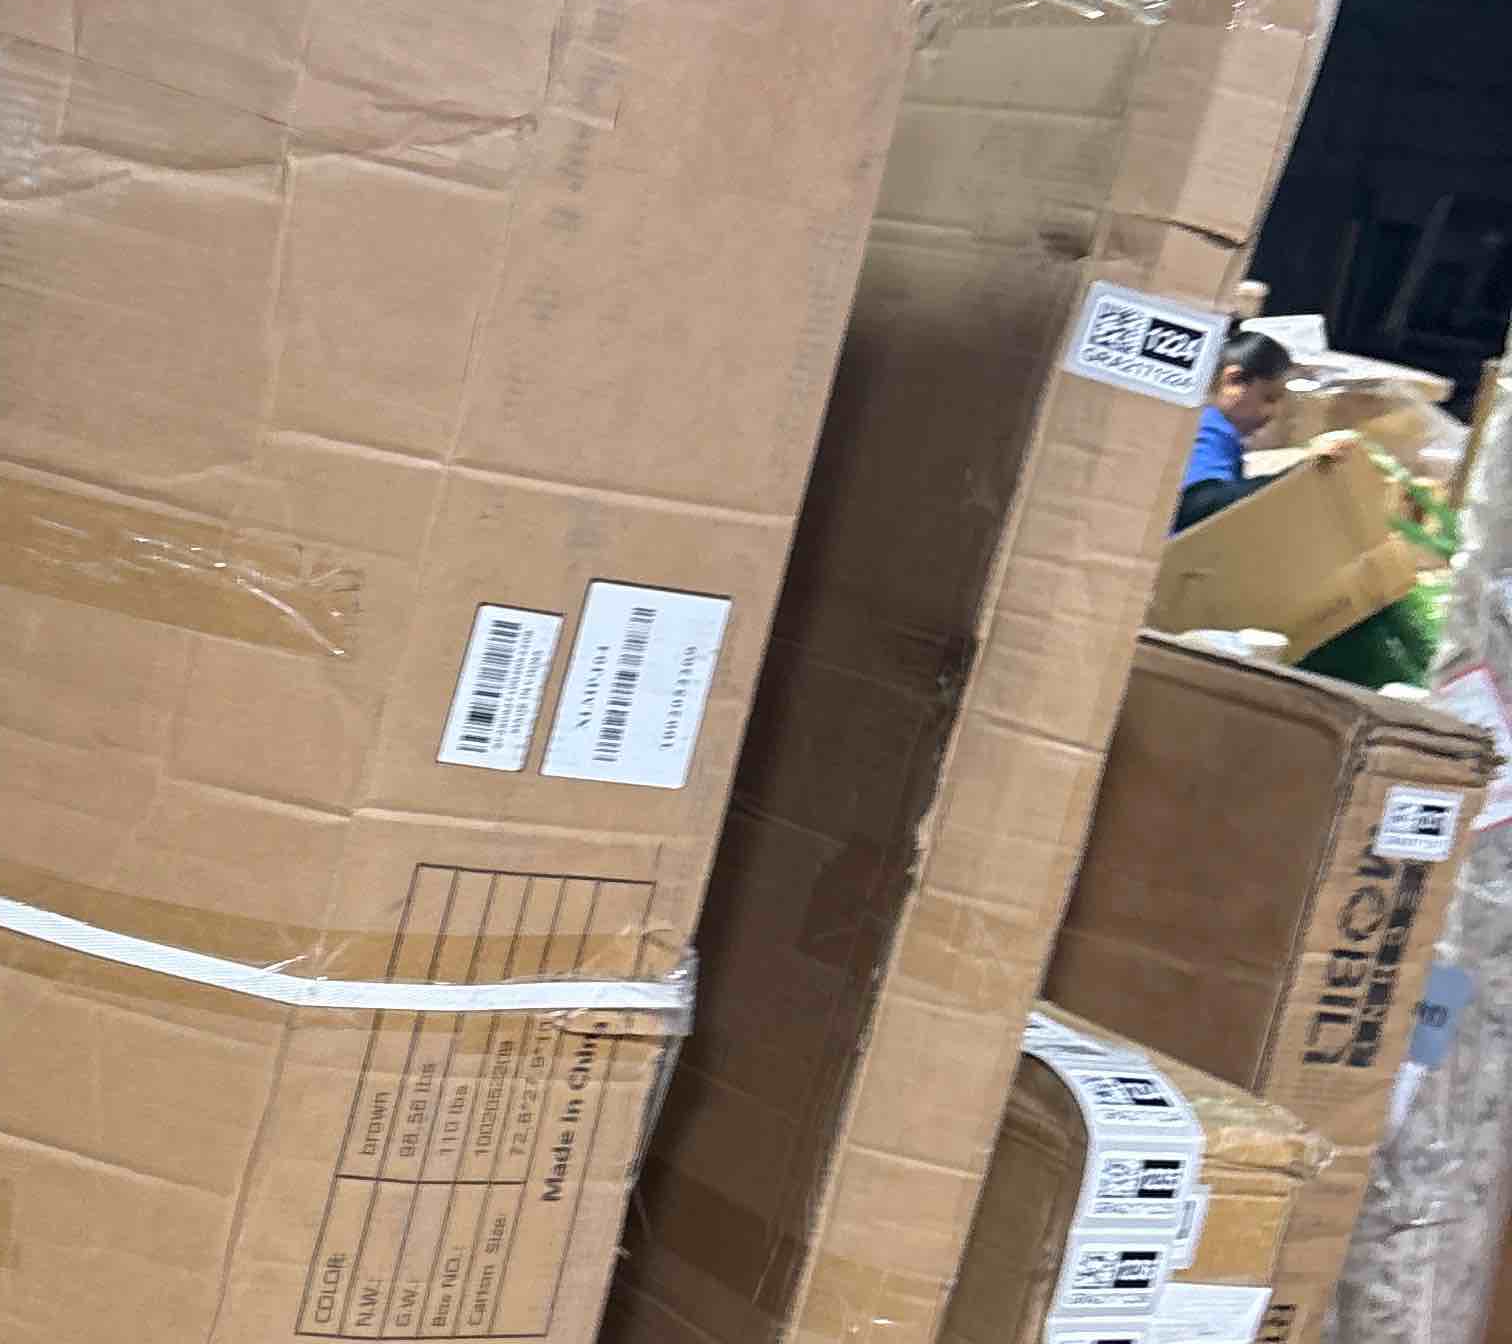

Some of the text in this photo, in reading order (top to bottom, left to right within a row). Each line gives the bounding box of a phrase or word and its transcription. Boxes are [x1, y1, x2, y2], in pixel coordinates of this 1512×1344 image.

[359, 1090, 392, 1156] brown
[439, 1118, 460, 1154] 110
[541, 1129, 575, 1202] Made
[569, 1021, 609, 1091] China
